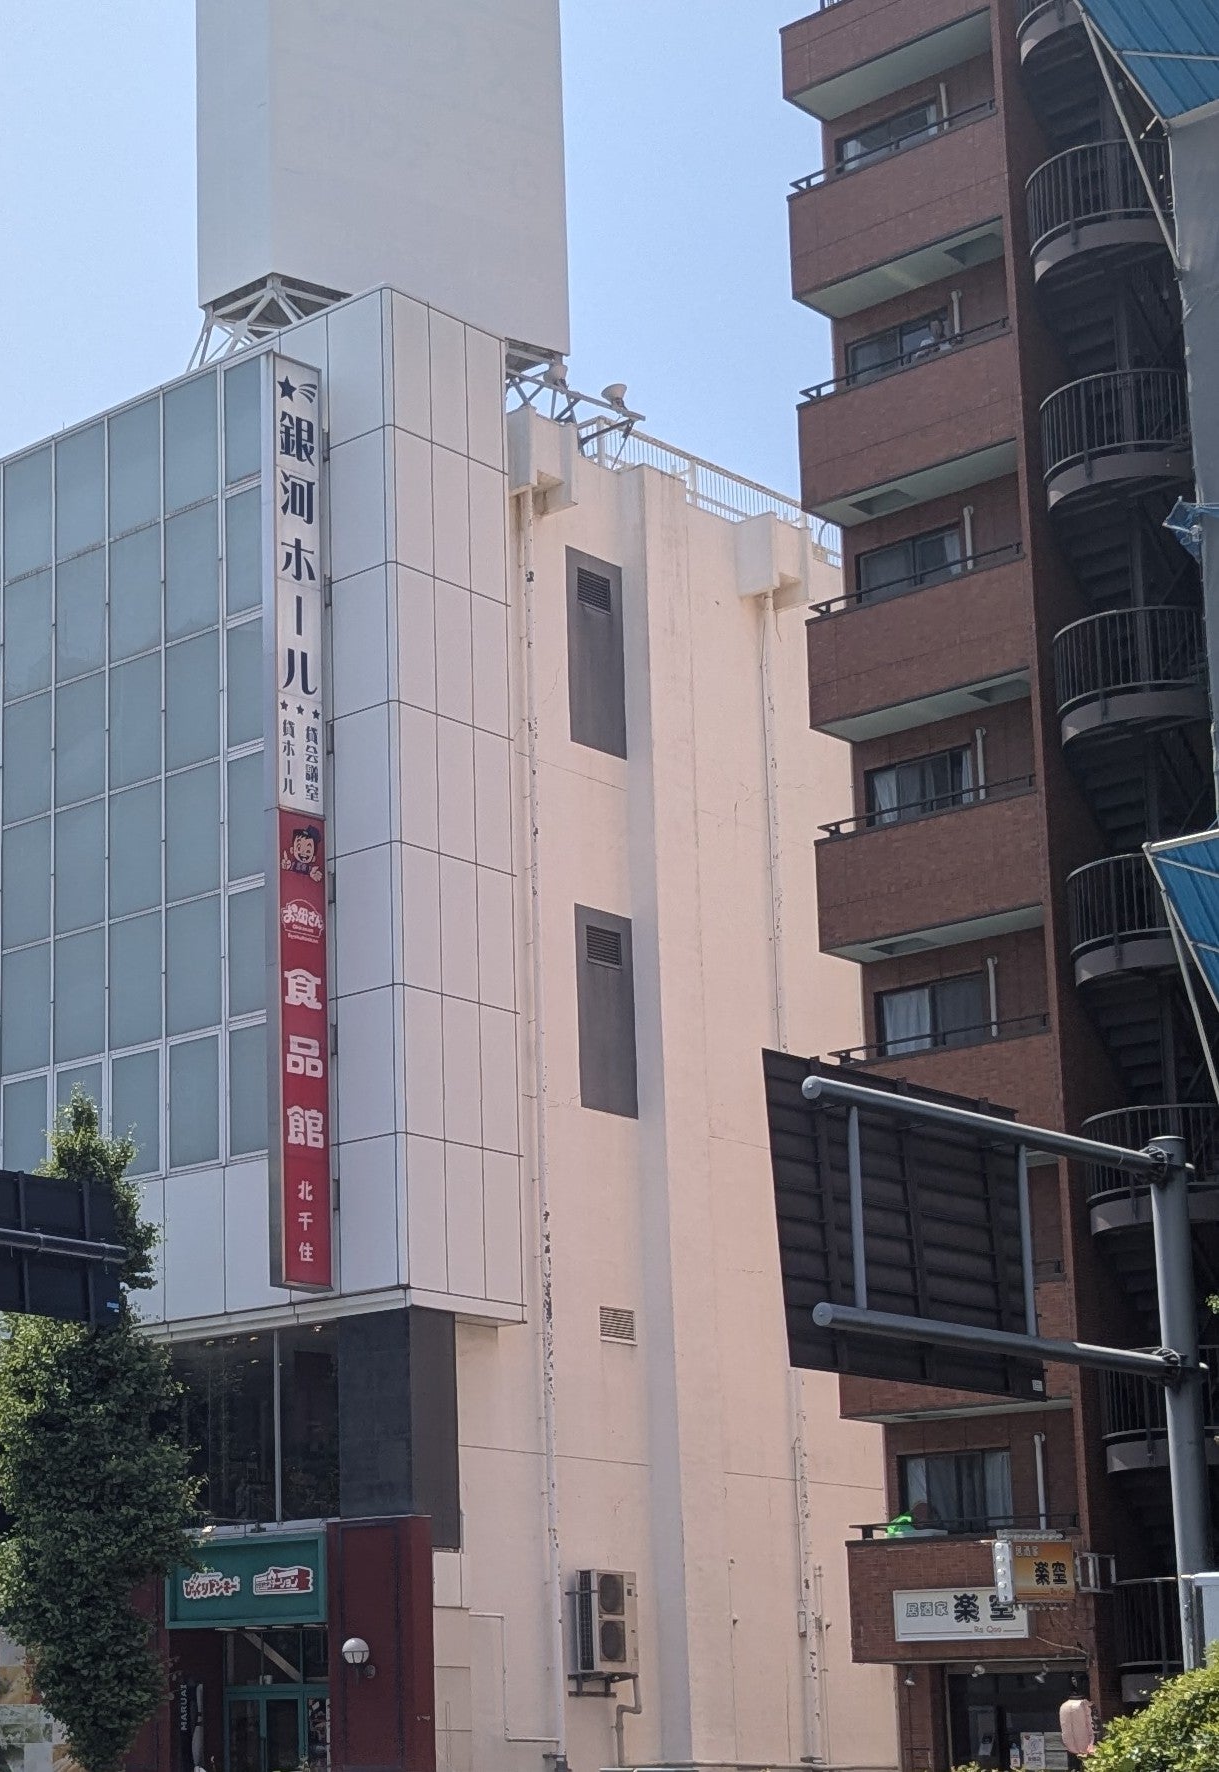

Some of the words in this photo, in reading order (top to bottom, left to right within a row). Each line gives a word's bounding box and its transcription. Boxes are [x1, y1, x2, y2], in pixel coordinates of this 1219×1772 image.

[279, 414, 318, 696] 銀河ホール
[281, 718, 296, 796] 貸ホール
[304, 725, 319, 802] 貸会議室
[284, 968, 324, 1149] 食品館
[297, 1180, 314, 1263] 北千住
[1033, 1561, 1067, 1586] 楽空
